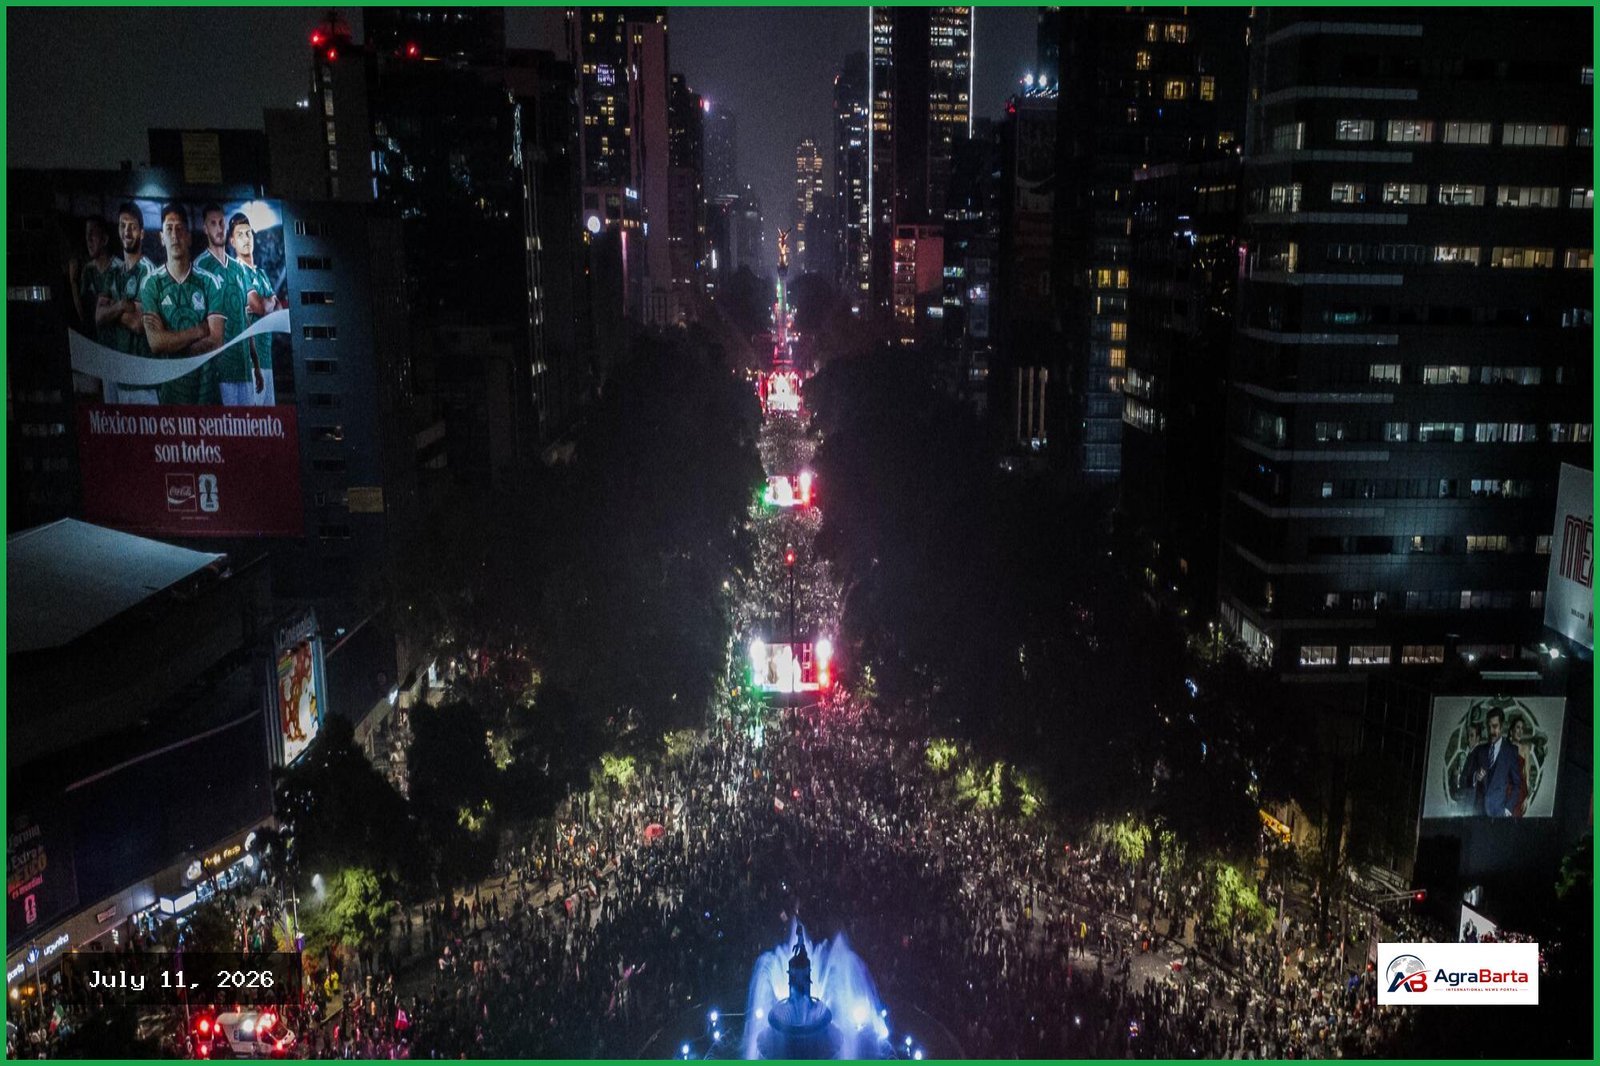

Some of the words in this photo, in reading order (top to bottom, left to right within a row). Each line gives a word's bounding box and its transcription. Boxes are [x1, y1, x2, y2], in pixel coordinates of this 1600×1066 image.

[89, 410, 137, 434] México
[140, 416, 158, 435] no
[160, 416, 175, 436] es
[178, 416, 197, 436] un
[199, 412, 285, 439] sentimiento,
[155, 443, 180, 463] son
[181, 439, 225, 464] todos.
